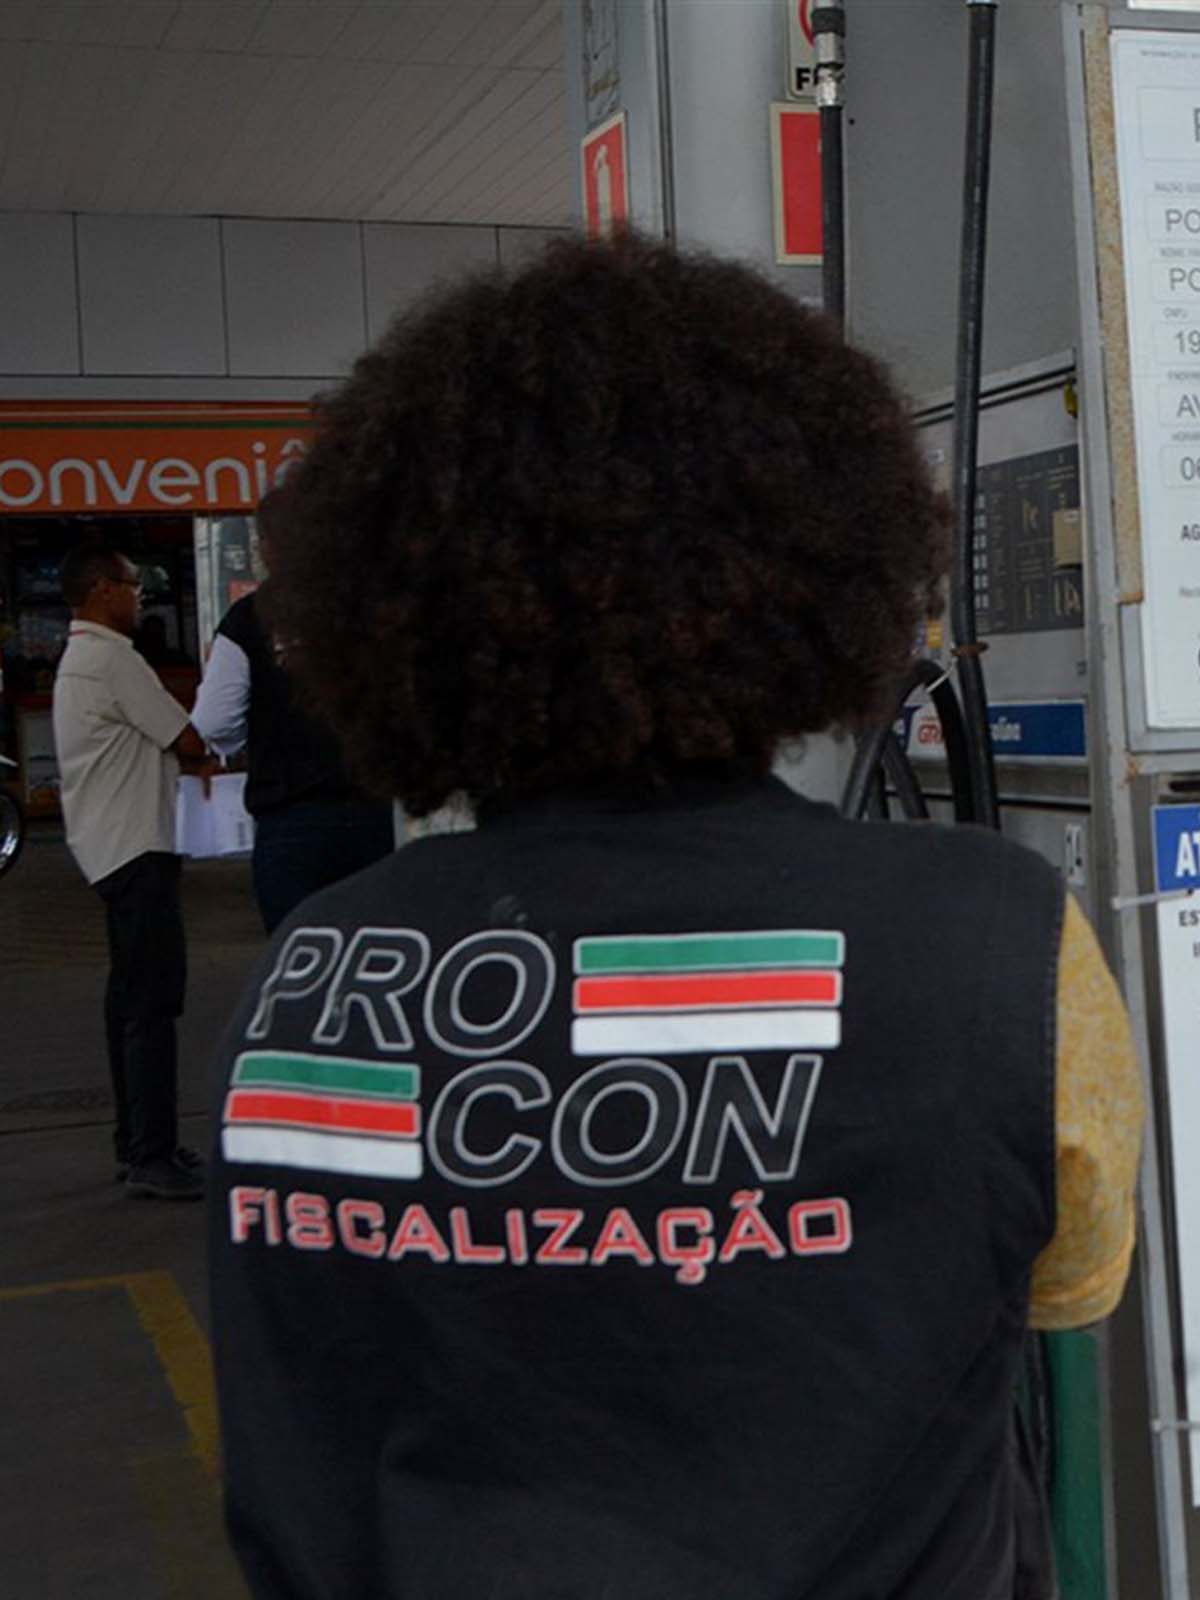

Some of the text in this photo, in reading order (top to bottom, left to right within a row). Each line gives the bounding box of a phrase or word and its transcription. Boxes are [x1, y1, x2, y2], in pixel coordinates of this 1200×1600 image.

[246, 927, 556, 1058] PRO
[427, 1053, 822, 1187] CON
[229, 1186, 852, 1285] FISCALIZAÇÃO
